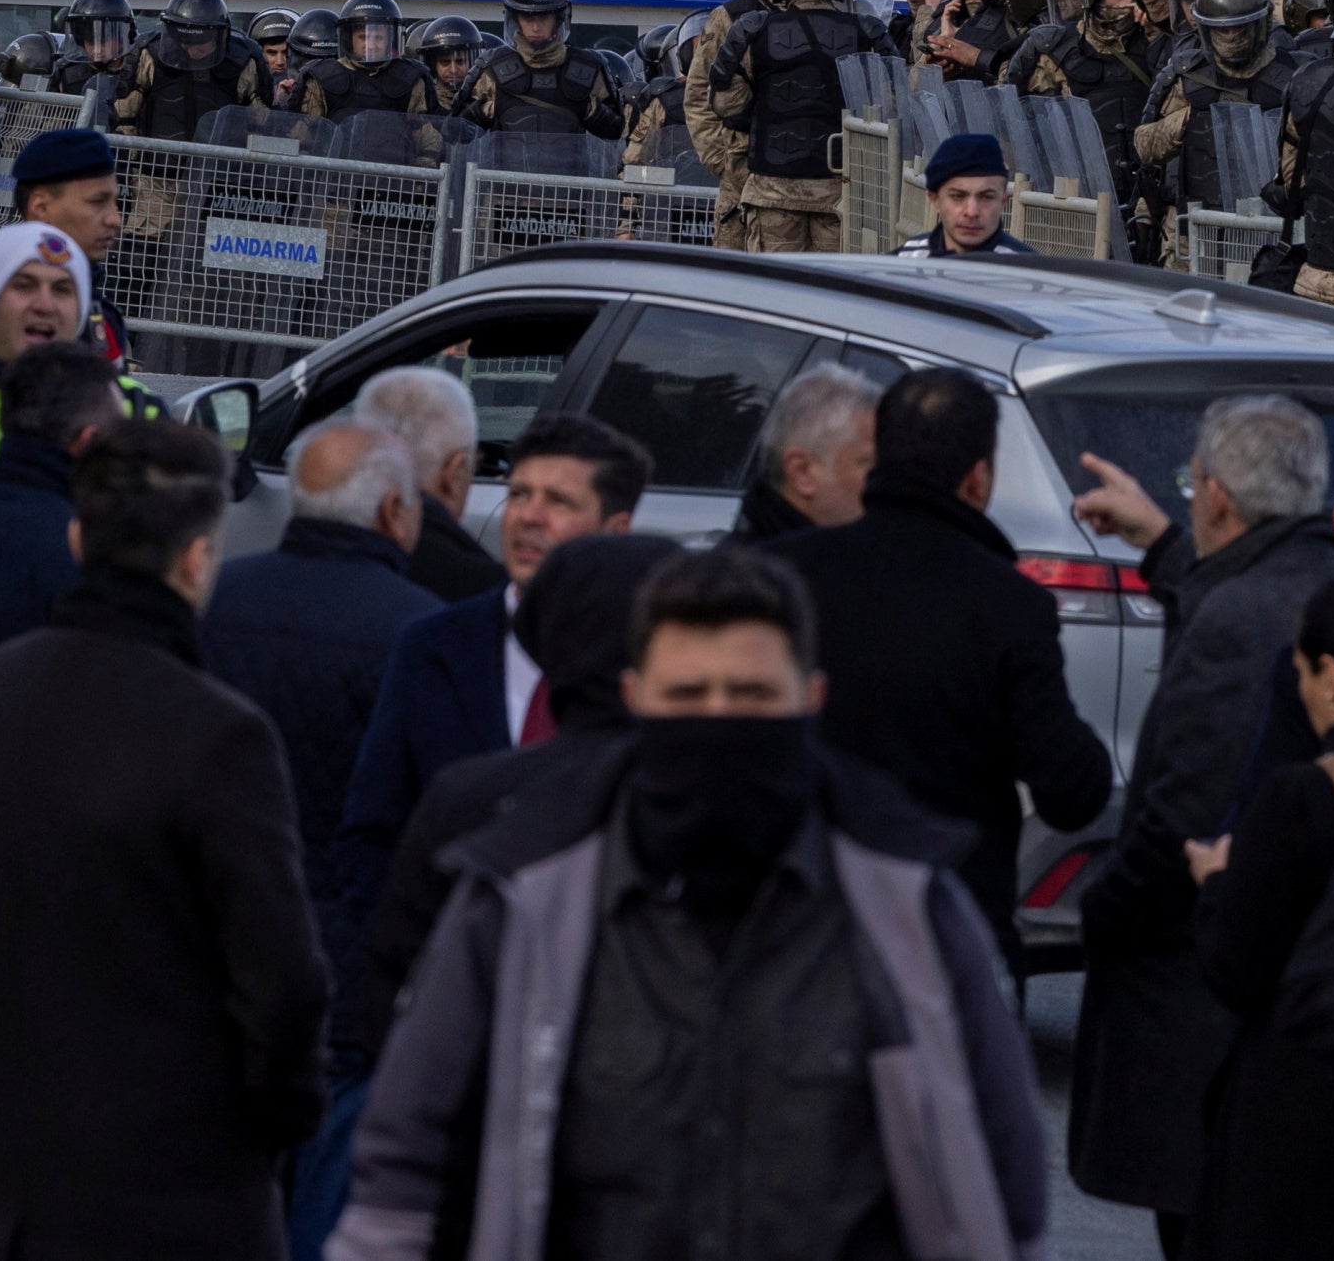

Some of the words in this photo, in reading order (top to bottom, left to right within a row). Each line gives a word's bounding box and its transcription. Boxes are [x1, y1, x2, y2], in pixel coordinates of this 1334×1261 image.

[361, 200, 437, 221] JANDARMA
[502, 218, 578, 236] JANDARMA
[210, 234, 318, 264] JANDARMA
